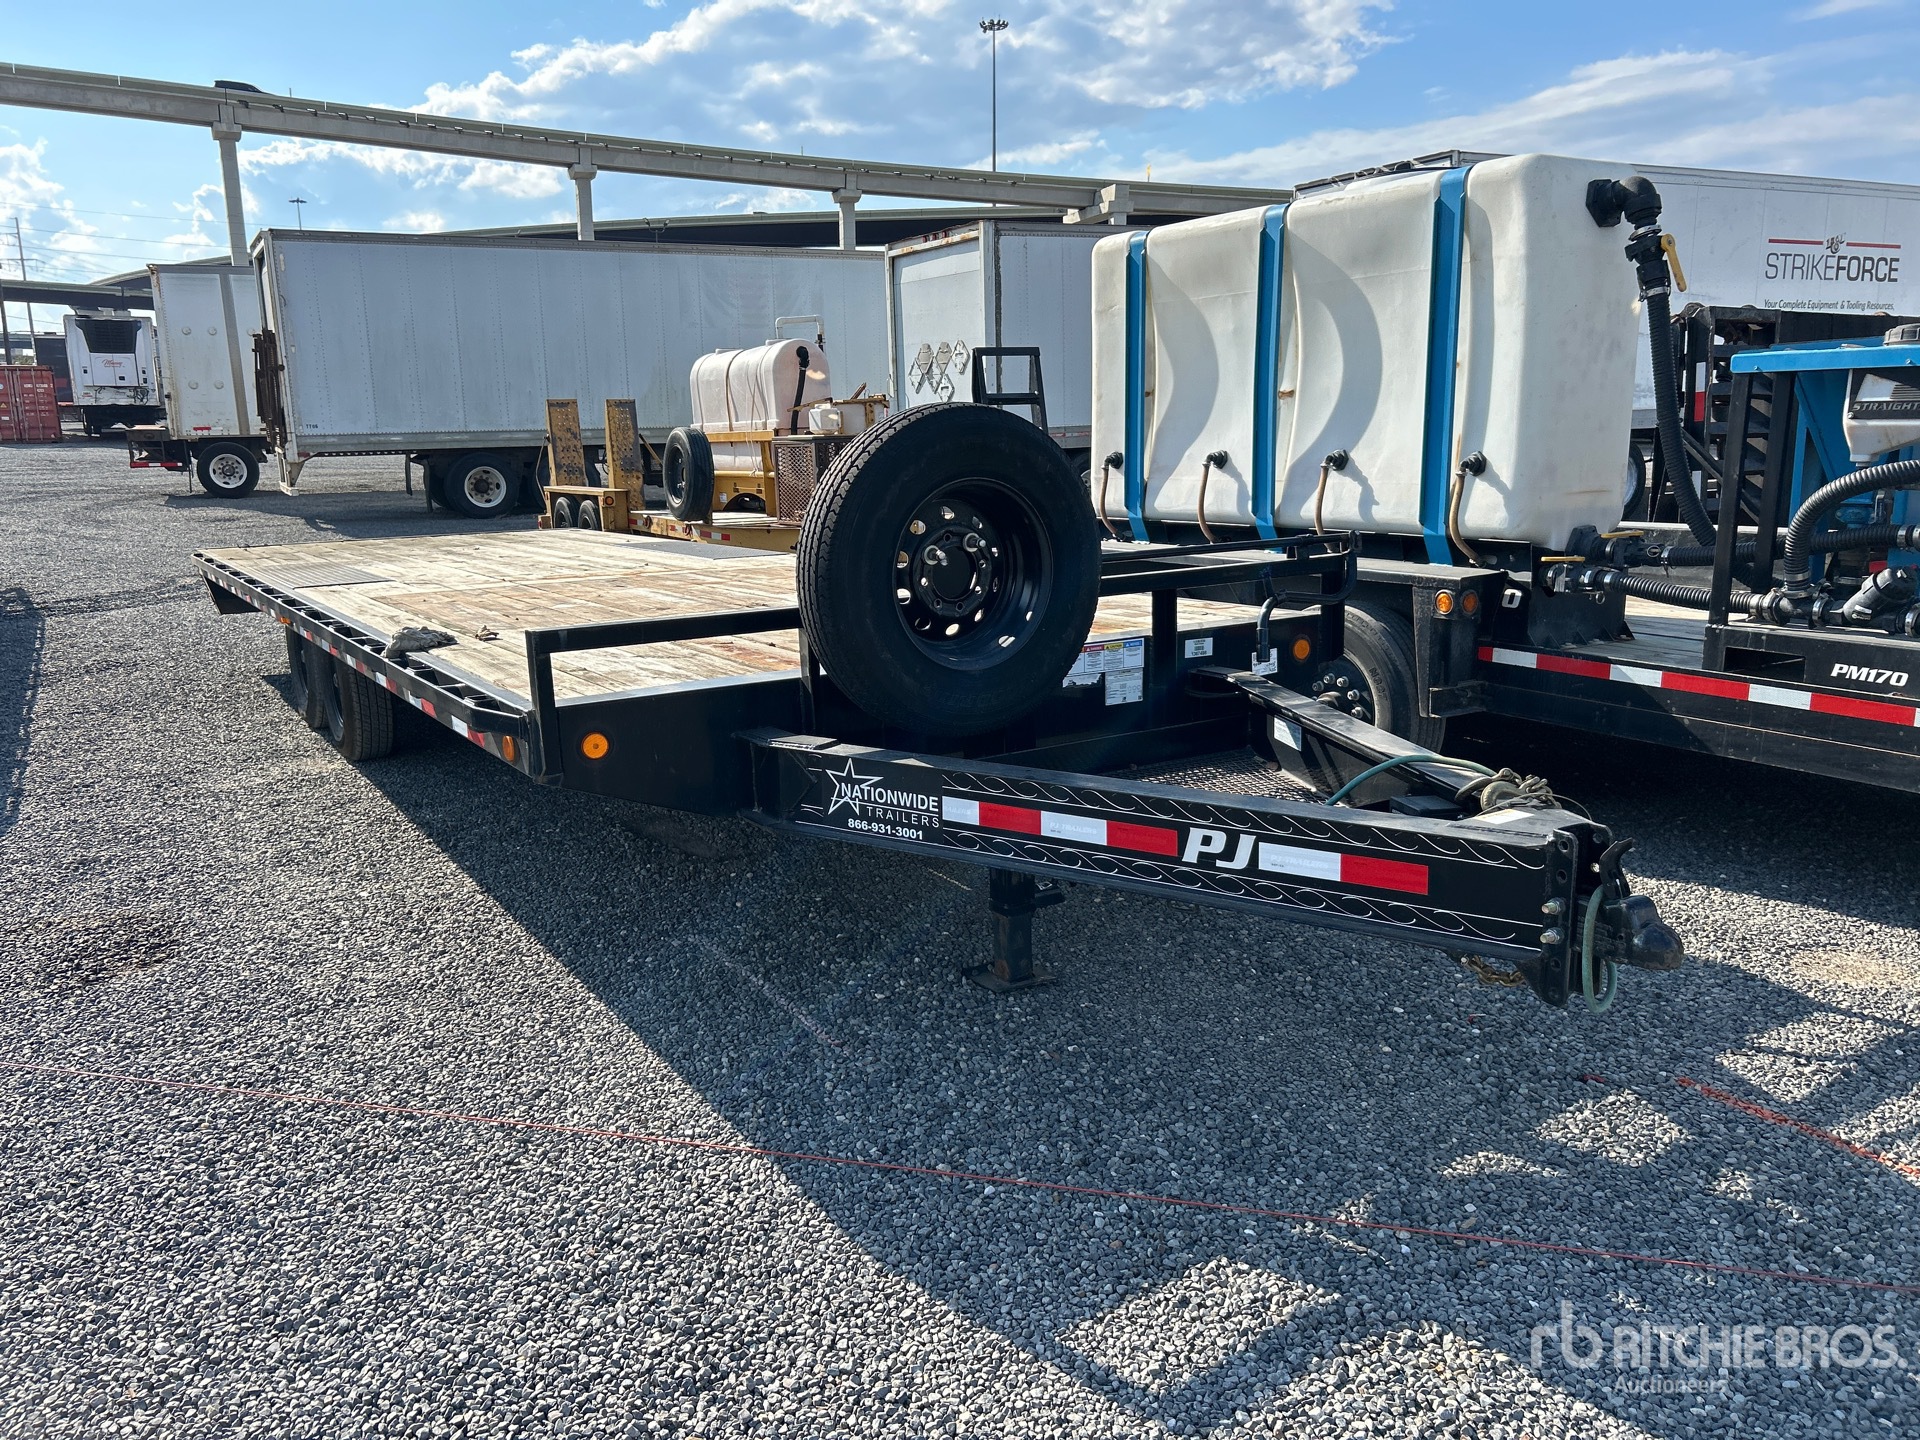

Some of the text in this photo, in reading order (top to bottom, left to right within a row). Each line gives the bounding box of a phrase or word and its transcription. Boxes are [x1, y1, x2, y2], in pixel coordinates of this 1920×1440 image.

[1765, 252, 1900, 282] STRIKEFORCE
[1764, 299, 1778, 309] Your
[1778, 299, 1806, 310] Complete
[1807, 300, 1839, 311] Equipment
[1840, 301, 1845, 309] &
[1846, 300, 1866, 311] Tooling
[1830, 663, 1909, 687] PM170
[841, 782, 939, 812] NATIONWIDE
[848, 818, 923, 840] 866-931-3001
[866, 806, 940, 828] TRAILERS
[1182, 827, 1256, 870] PJ
